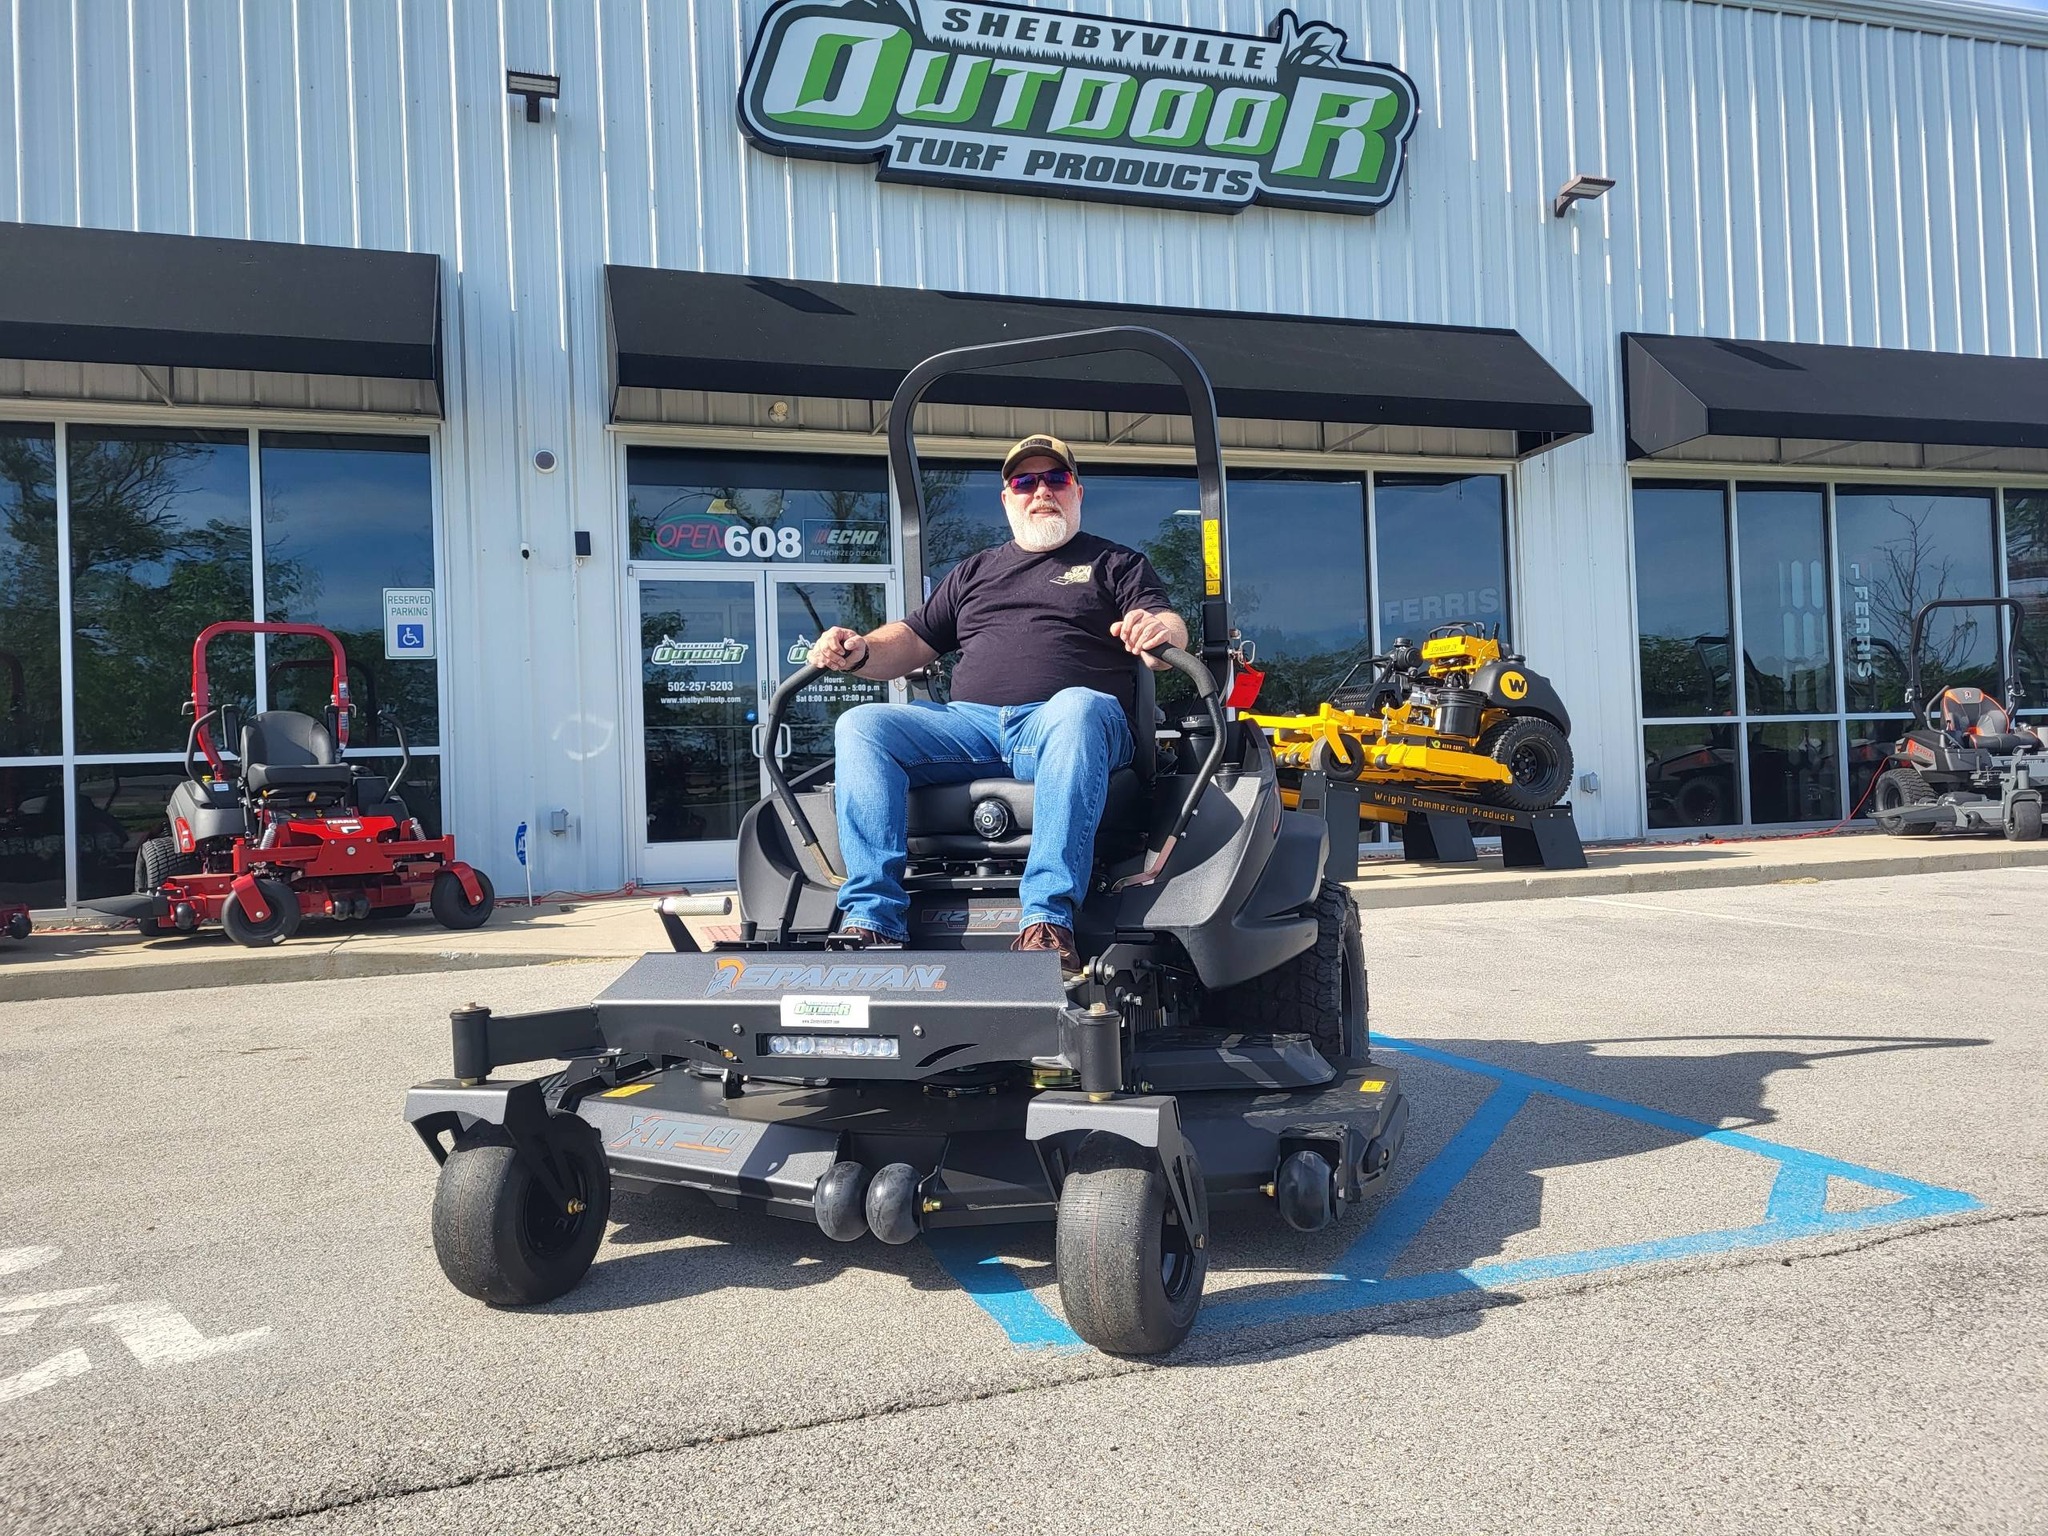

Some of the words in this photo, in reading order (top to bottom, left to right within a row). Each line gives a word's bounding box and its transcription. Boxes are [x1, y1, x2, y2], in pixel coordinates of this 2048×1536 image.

[941, 8, 1266, 70] SHELBYVILLE
[762, 16, 1398, 185] OUTDOOR
[895, 135, 1008, 170] TURF
[1022, 148, 1253, 196] PRODUCTS
[656, 522, 726, 549] OPEN
[724, 525, 802, 558] 608
[826, 529, 879, 545] ECHO
[810, 549, 854, 557] AUTHORIZED
[387, 595, 431, 605] RESERVED
[1384, 587, 1499, 625] FERRIS
[391, 607, 428, 616] PARKING
[1854, 586, 1872, 677] FERRIS
[654, 647, 743, 661] OUTDOOR
[667, 681, 734, 692] 502-257-5203
[808, 684, 818, 692] Fri
[852, 684, 867, 692] 5:00
[1508, 678, 1526, 693] W
[660, 695, 741, 704] www.shelbyvilleotp.com
[841, 694, 860, 702] 12:00
[1374, 791, 1406, 805] Wright
[1411, 797, 1468, 815] Commercial
[1472, 807, 1515, 822] Products
[736, 966, 945, 989] SPARTAN
